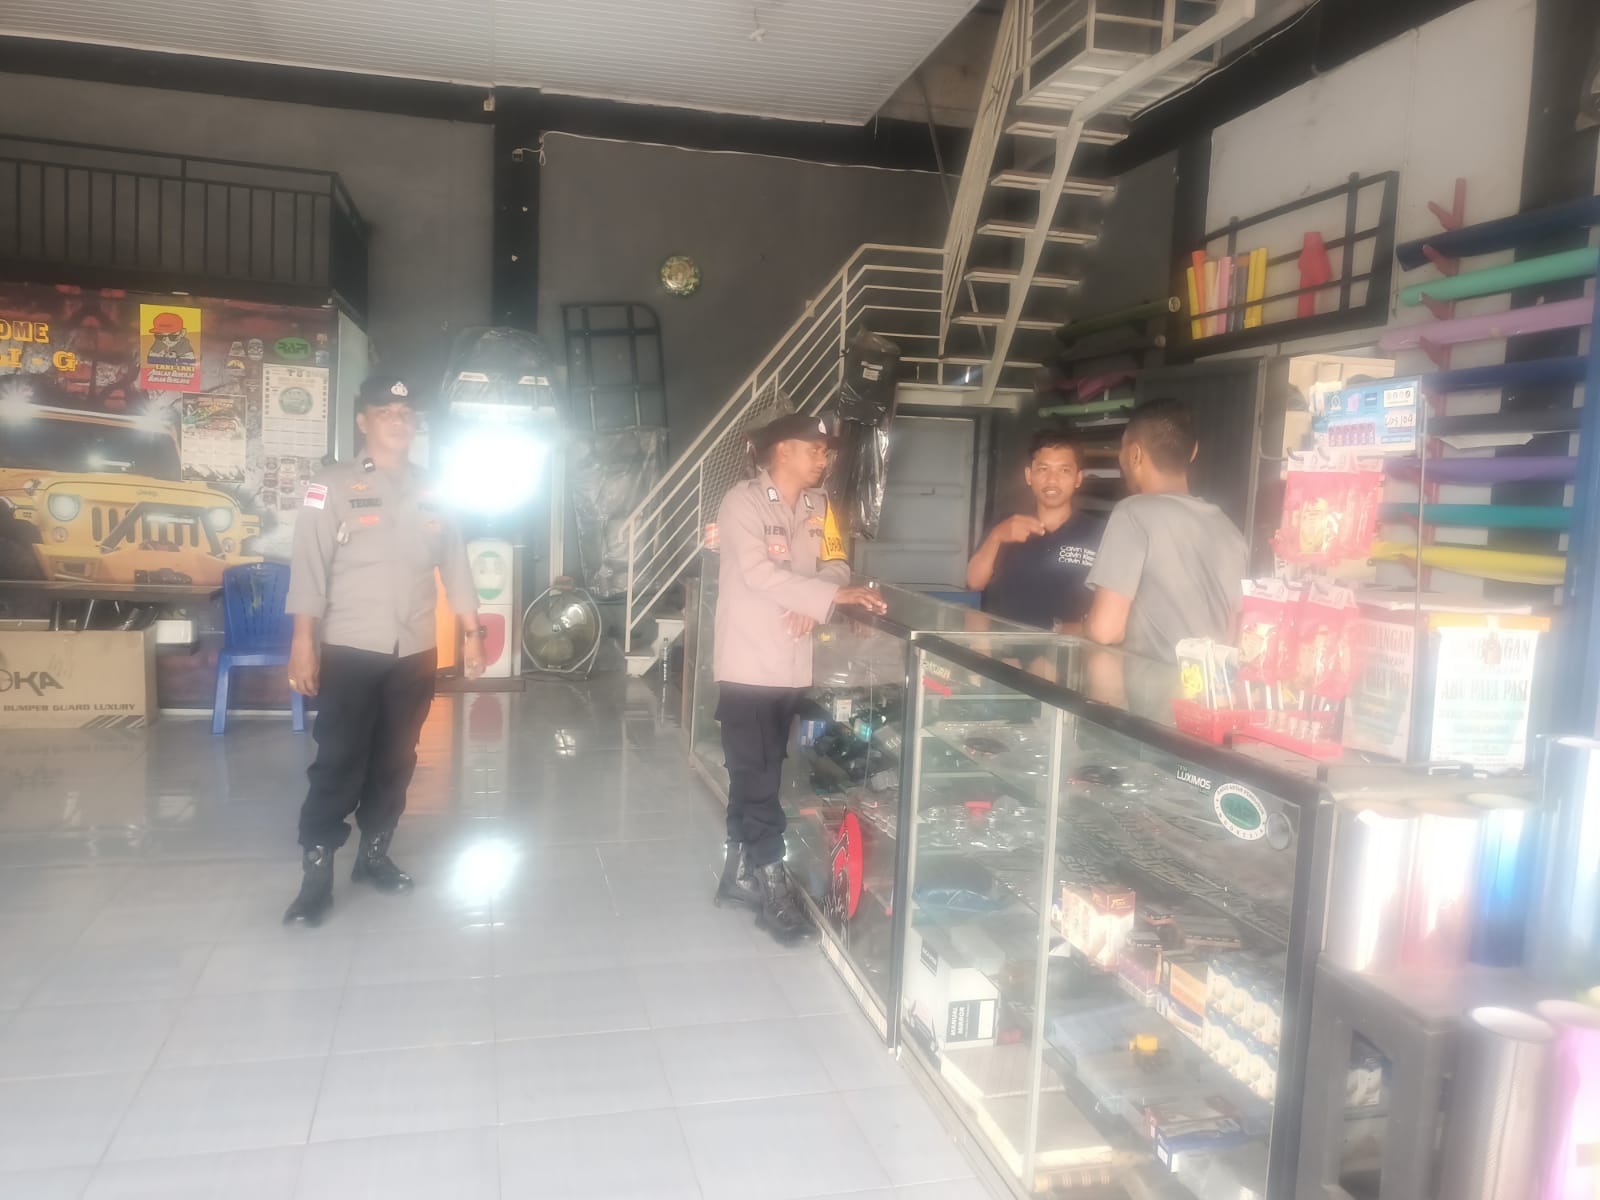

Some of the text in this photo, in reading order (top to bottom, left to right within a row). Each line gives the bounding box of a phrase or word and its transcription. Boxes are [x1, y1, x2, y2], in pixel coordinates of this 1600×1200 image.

[3, 704, 49, 712] BUMPER
[94, 703, 136, 711] LUXURY
[1176, 769, 1212, 790] LUXIMOS
